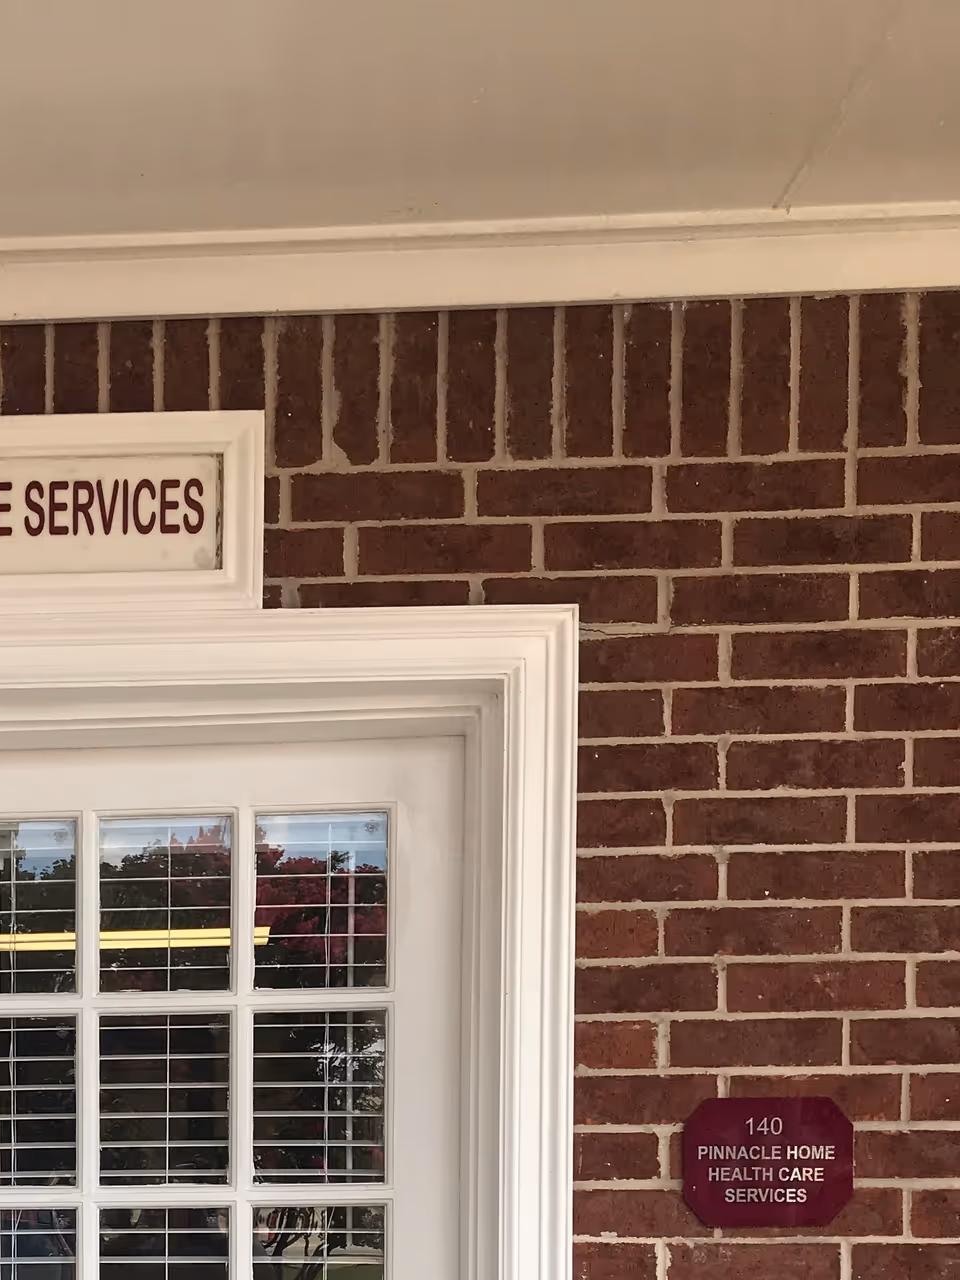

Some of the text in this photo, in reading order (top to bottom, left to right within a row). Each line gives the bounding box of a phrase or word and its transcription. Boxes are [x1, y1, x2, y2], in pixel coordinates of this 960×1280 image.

[23, 478, 206, 536] SERVICES
[745, 1117, 782, 1135] 140
[698, 1146, 835, 1160] PINNACLE HOME
[708, 1168, 824, 1181] HEALTH CARE
[725, 1188, 807, 1202] SERVICES
